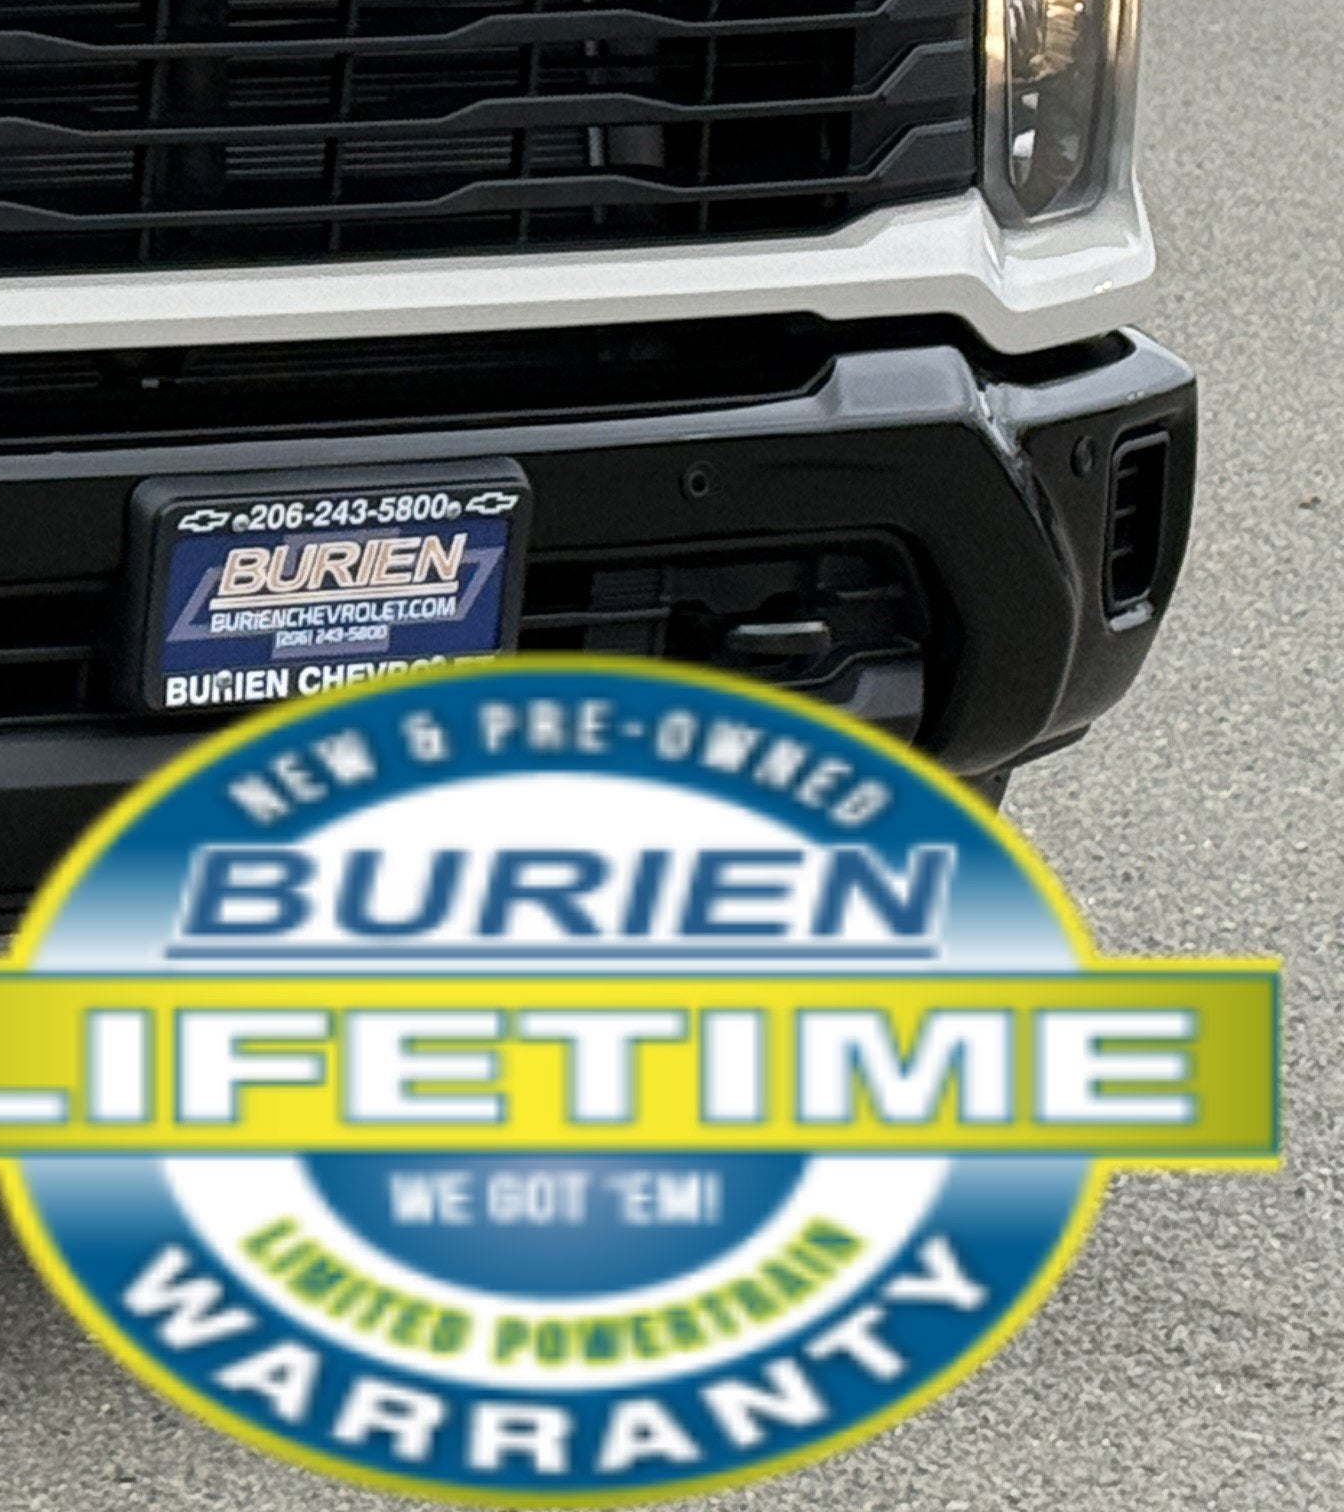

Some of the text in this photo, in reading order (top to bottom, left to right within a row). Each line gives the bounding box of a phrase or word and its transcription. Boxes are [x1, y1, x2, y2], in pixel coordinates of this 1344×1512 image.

[247, 493, 449, 531] 206-243-5800
[216, 532, 469, 597] BURIEN
[209, 596, 458, 634] BURIENCHEVROLET.COM
[164, 667, 290, 707] BURIEN
